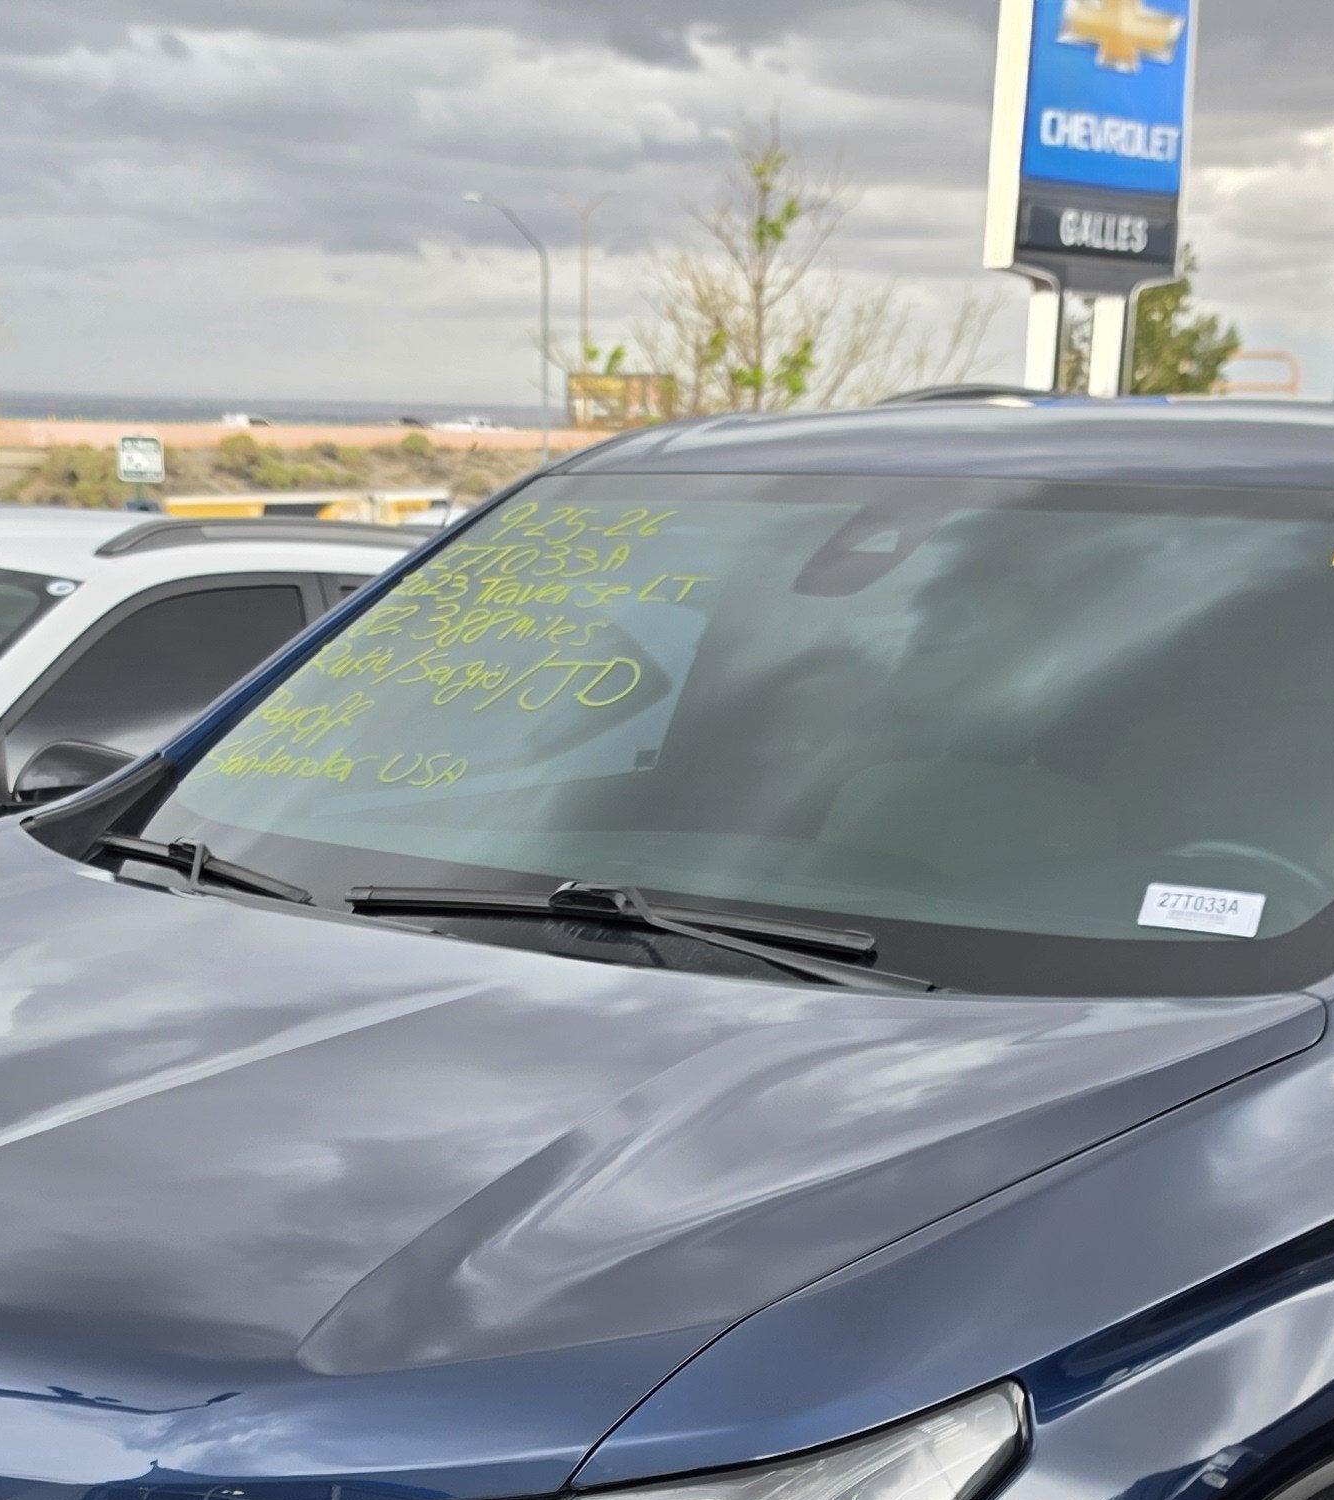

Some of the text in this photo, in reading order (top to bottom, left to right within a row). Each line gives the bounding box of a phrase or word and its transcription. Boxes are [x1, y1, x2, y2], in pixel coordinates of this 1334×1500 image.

[1039, 108, 1181, 162] CHEVROLET
[1059, 207, 1148, 253] GALLES
[429, 543, 631, 577] 27T033A
[637, 573, 714, 603] LT
[378, 753, 467, 788] USA
[1157, 893, 1239, 915] 27T033A
